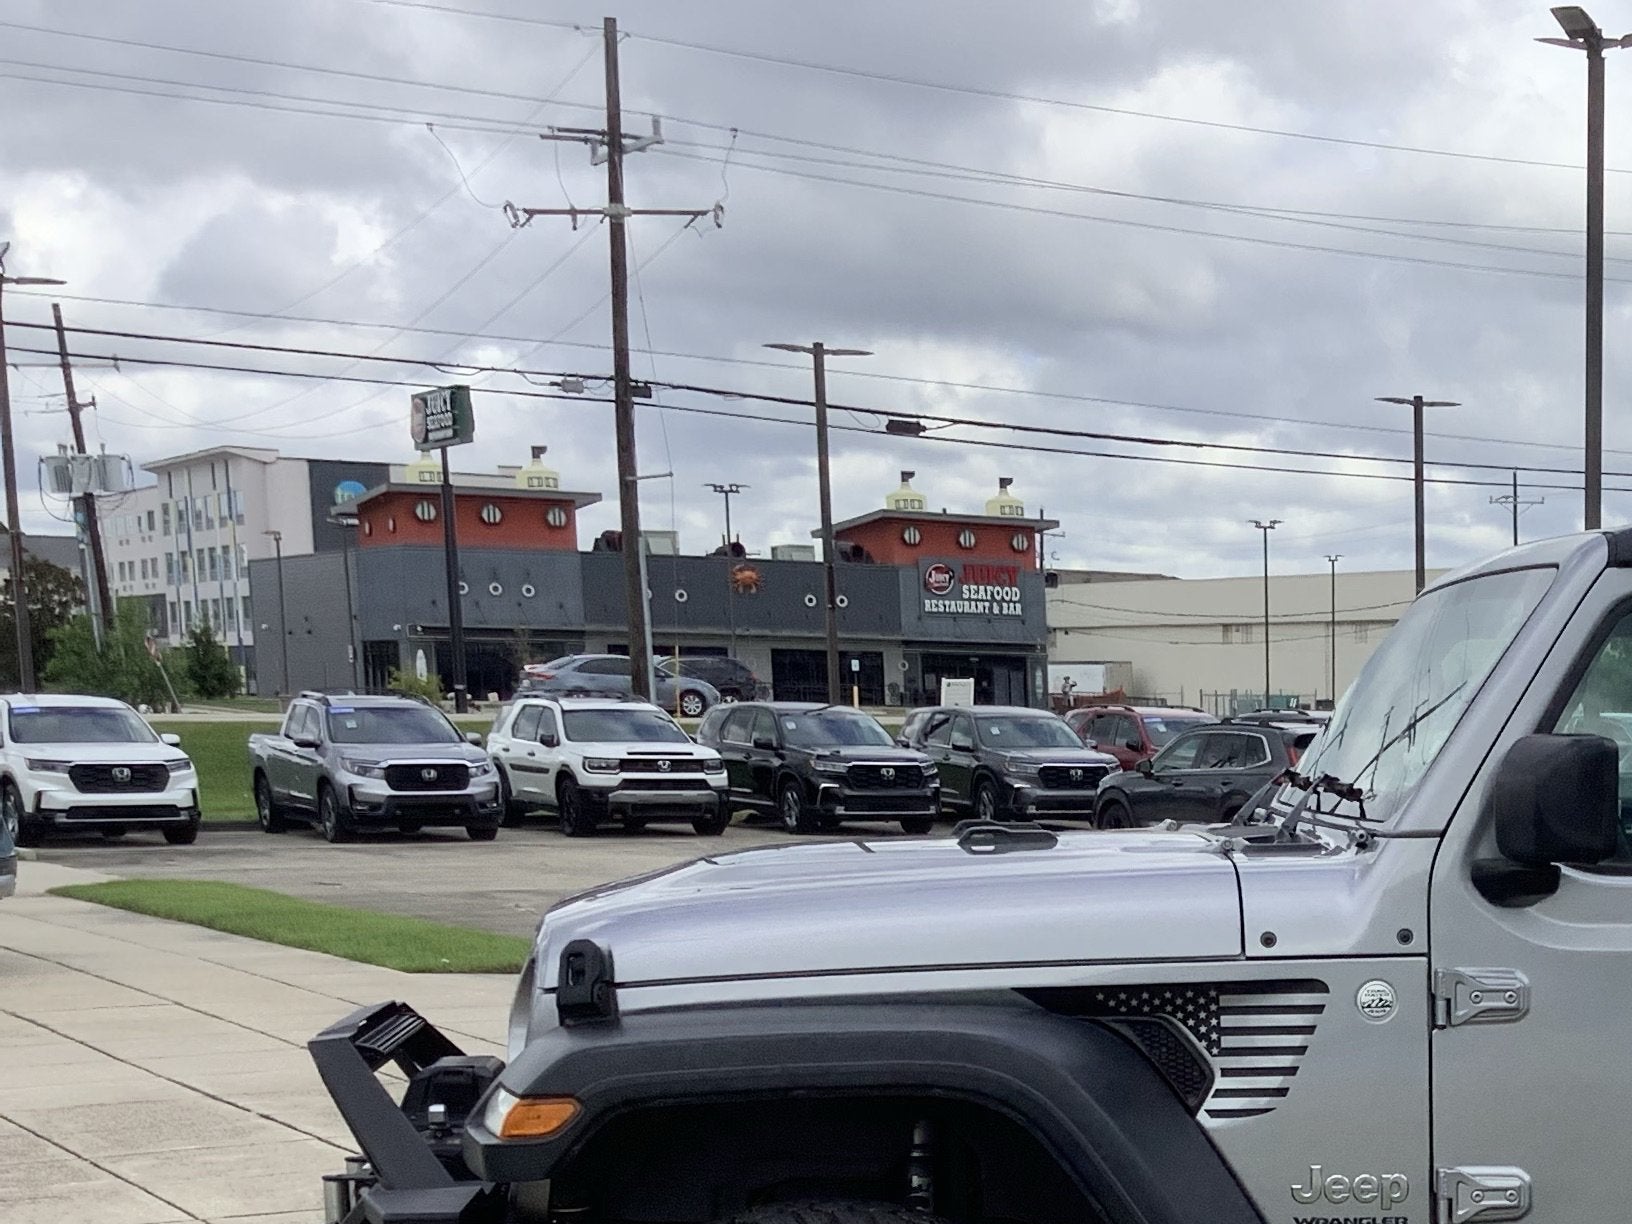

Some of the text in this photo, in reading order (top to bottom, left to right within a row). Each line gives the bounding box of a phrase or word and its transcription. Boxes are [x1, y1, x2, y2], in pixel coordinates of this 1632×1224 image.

[425, 389, 452, 415] JUICY
[959, 565, 1019, 585] JUICY
[962, 585, 1021, 602] SEAFOOD
[924, 600, 1022, 616] RESTAURANT & BAR
[1290, 1163, 1409, 1211] Jeep
